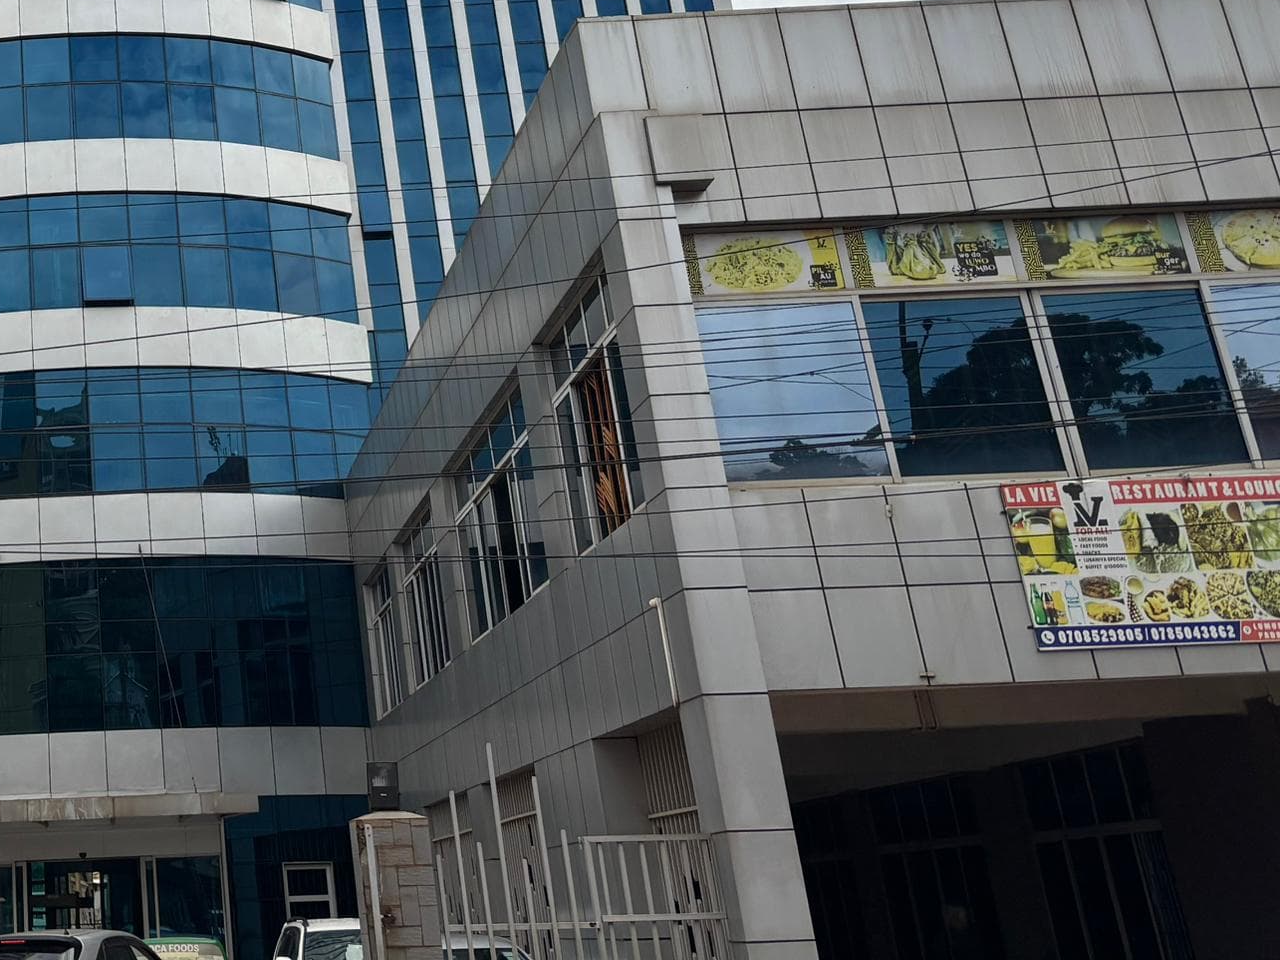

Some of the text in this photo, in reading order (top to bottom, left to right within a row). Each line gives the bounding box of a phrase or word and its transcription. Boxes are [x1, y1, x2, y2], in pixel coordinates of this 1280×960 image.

[956, 243, 978, 252] YES
[1004, 486, 1057, 503] LA VIE
[1110, 481, 1219, 500] RESTAURANT
[168, 944, 200, 952] FOODS
